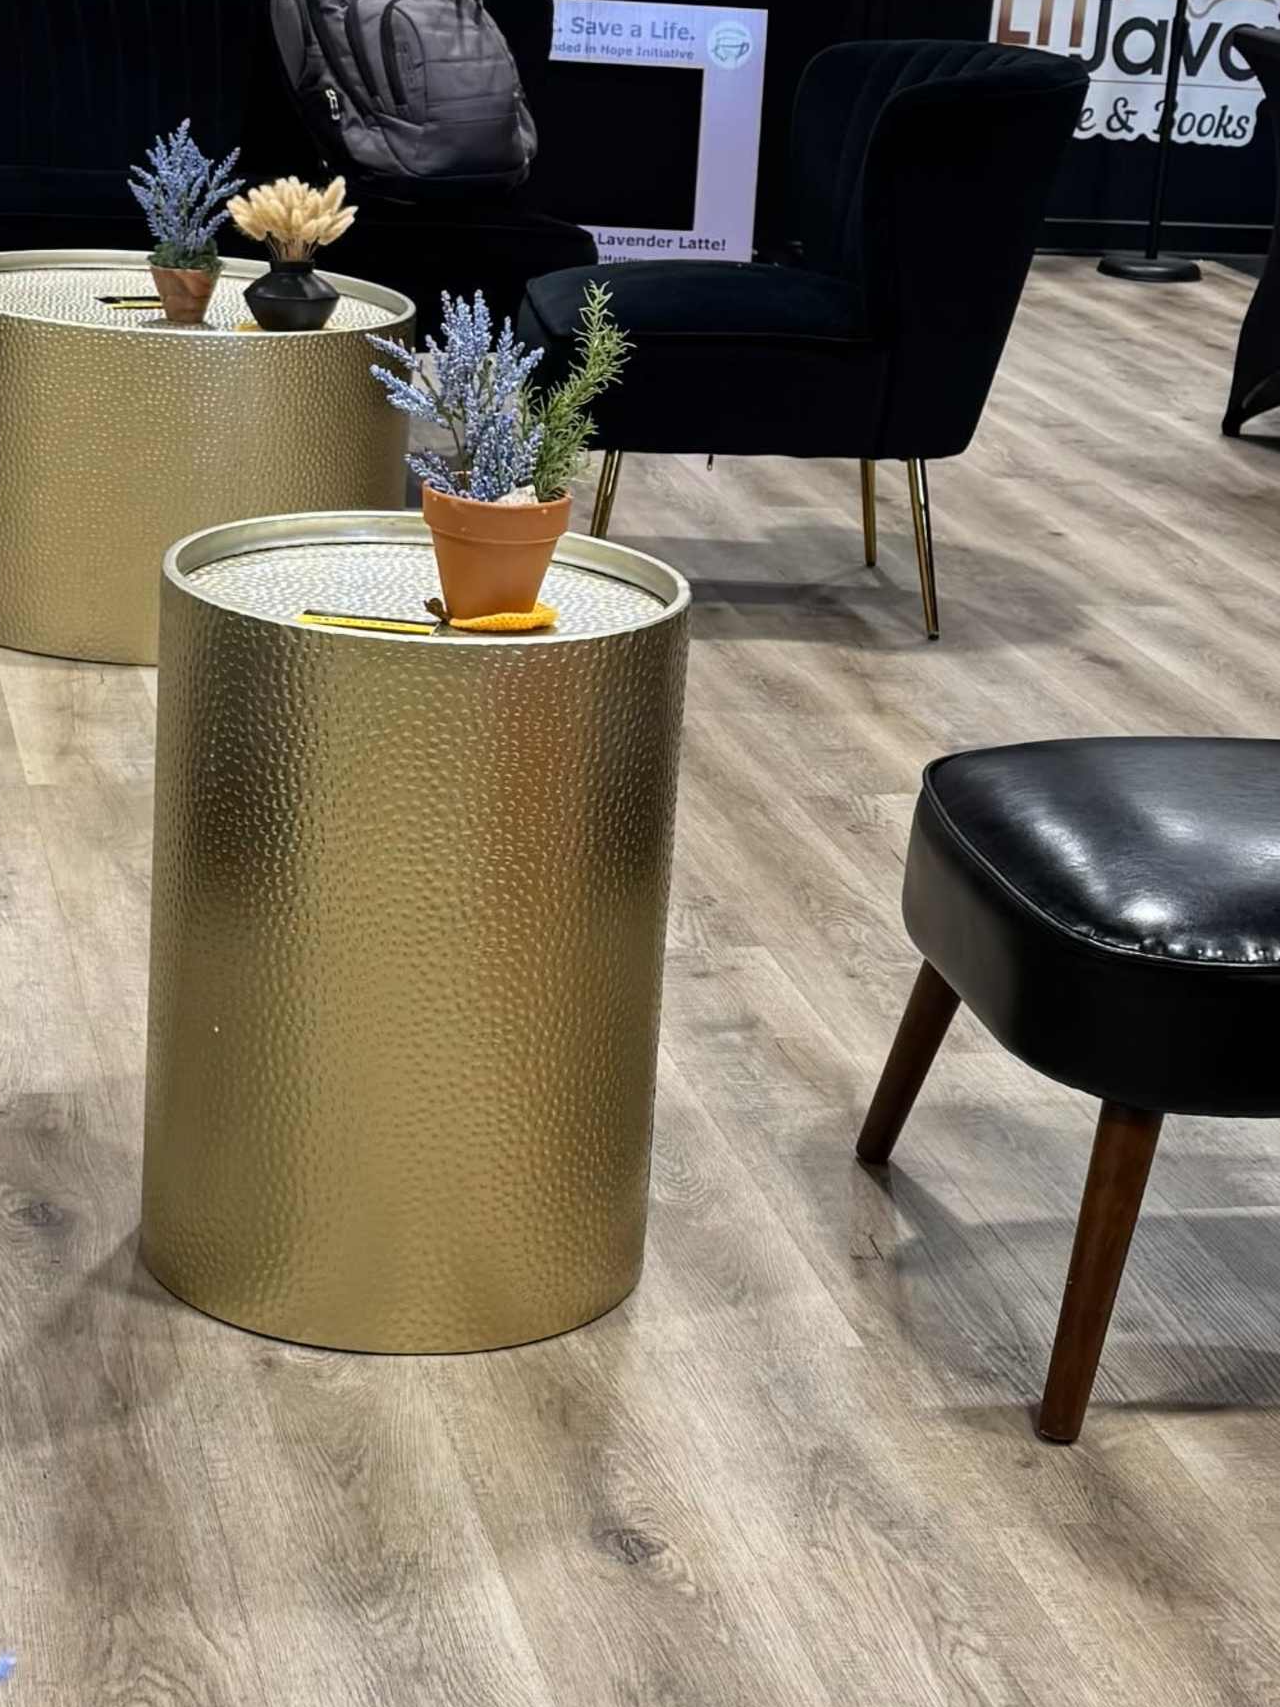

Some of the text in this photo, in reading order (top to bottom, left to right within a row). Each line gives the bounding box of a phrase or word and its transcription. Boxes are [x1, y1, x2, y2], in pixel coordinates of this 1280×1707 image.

[570, 16, 623, 37] Save
[630, 24, 642, 38] a
[651, 21, 696, 42] Life.
[585, 44, 597, 55] in
[601, 45, 633, 59] Hope
[637, 47, 695, 61] Initiative
[597, 232, 727, 252] Lavender Latte!
